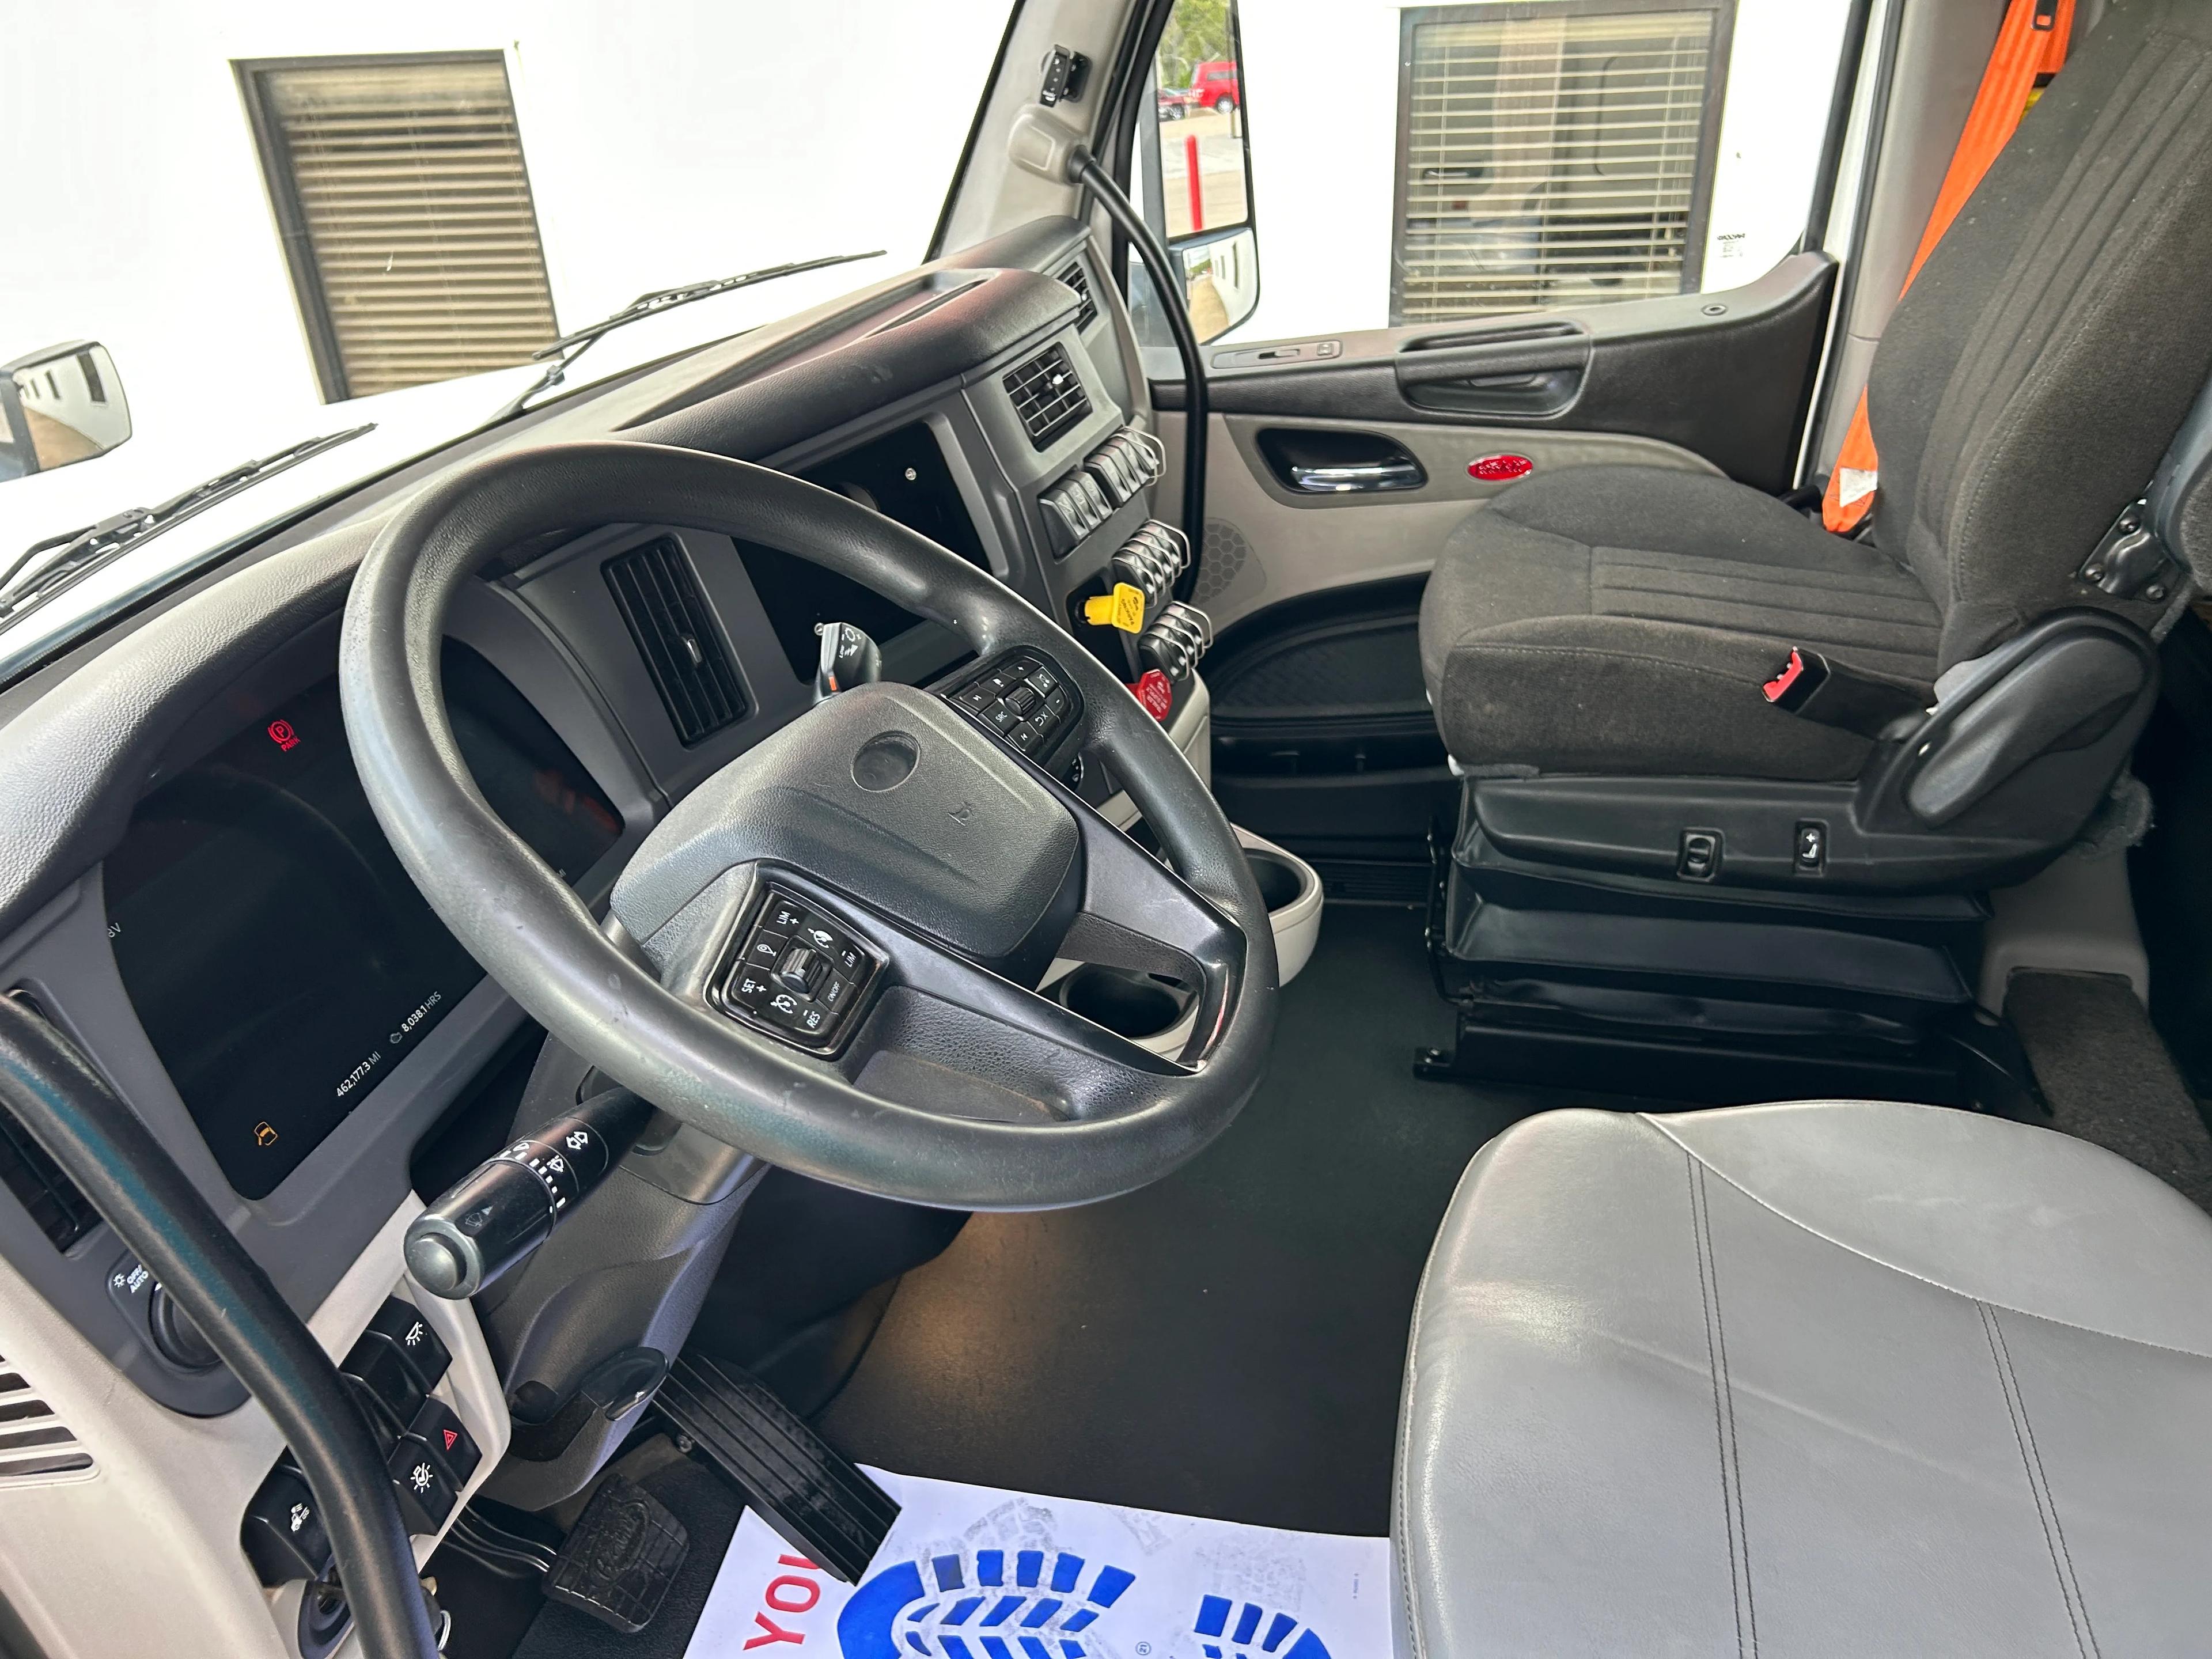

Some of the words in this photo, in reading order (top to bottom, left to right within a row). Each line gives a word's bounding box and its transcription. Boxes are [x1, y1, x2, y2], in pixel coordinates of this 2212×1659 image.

[995, 711, 1007, 722] SRC
[276, 726, 284, 737] P
[281, 737, 301, 751] PARK
[777, 911, 790, 925] LIM
[844, 952, 857, 968] LIM
[741, 979, 756, 993] SET
[827, 981, 840, 1002] ON/OFF
[401, 1005, 427, 1032] 8,038.1
[424, 991, 441, 1009] HRS
[806, 1011, 820, 1028] RES
[336, 1061, 371, 1096] 462,177.3
[368, 1051, 381, 1065] MI
[130, 1271, 149, 1293] AUTO
